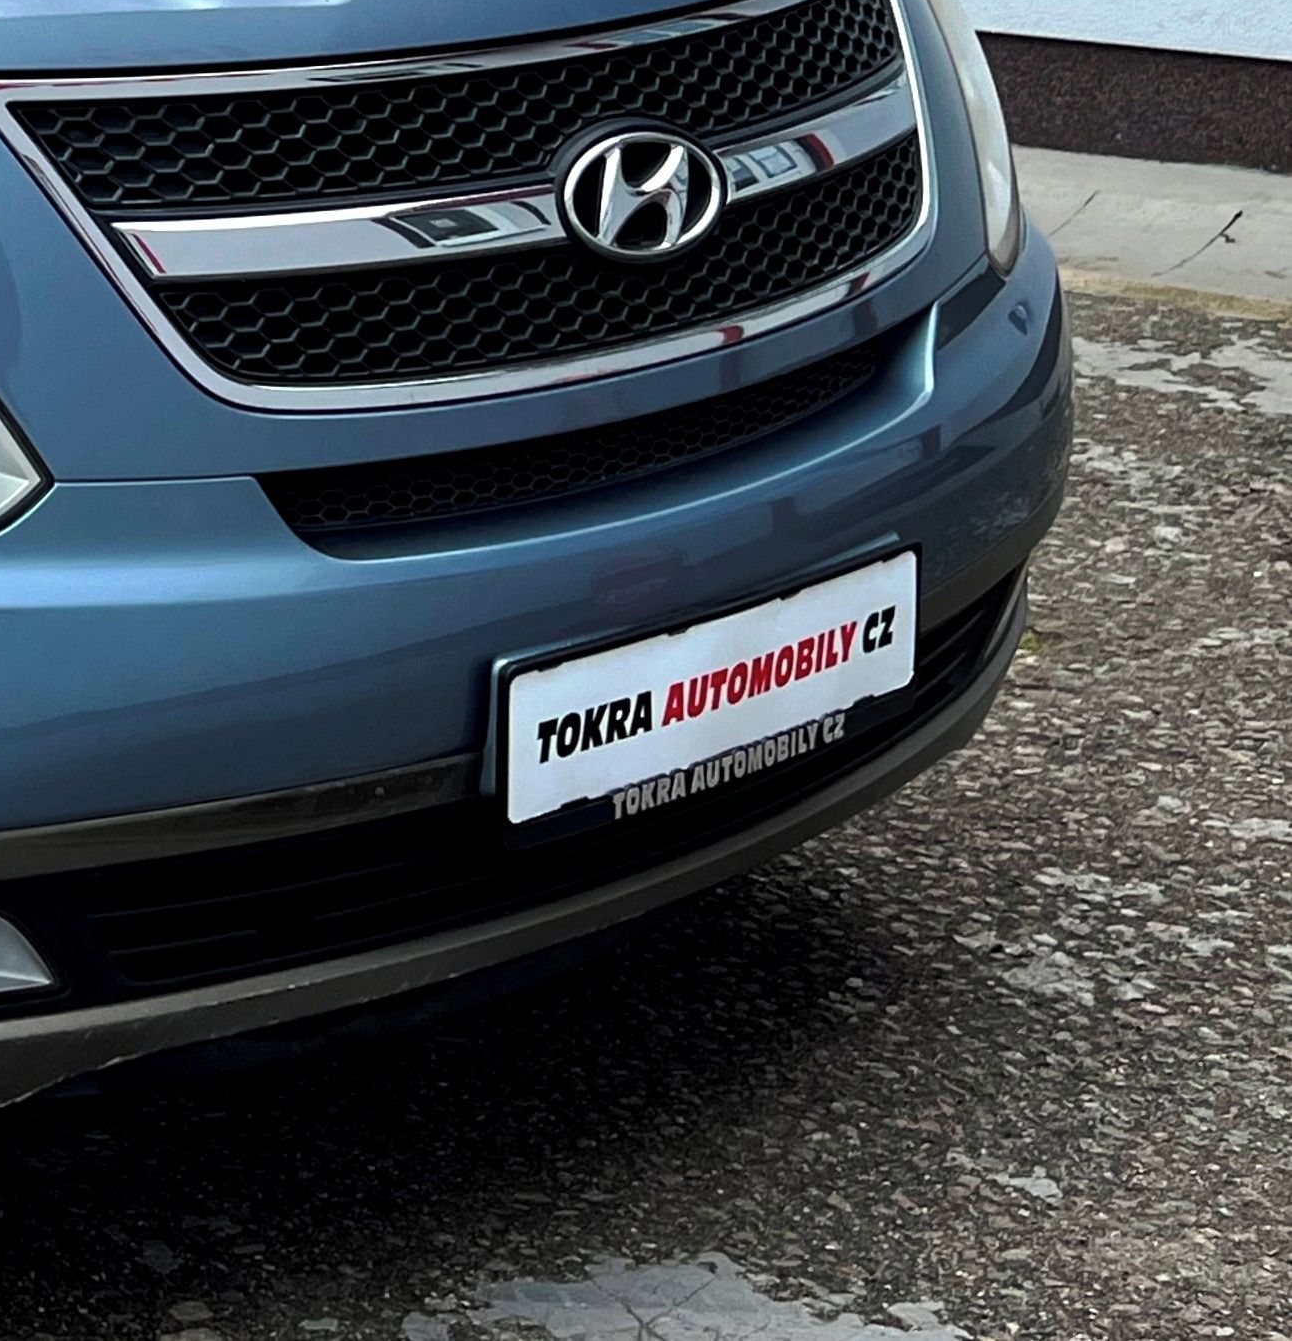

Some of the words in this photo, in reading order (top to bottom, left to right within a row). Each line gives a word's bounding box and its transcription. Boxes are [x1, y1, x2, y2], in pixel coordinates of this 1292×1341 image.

[537, 691, 653, 764] TOKRA
[661, 621, 858, 726] AUTOMOBILY
[862, 604, 897, 654] CZ
[612, 771, 687, 820] TOKRA
[690, 722, 819, 794] AUTOMOBILY
[822, 712, 847, 744] CZ
